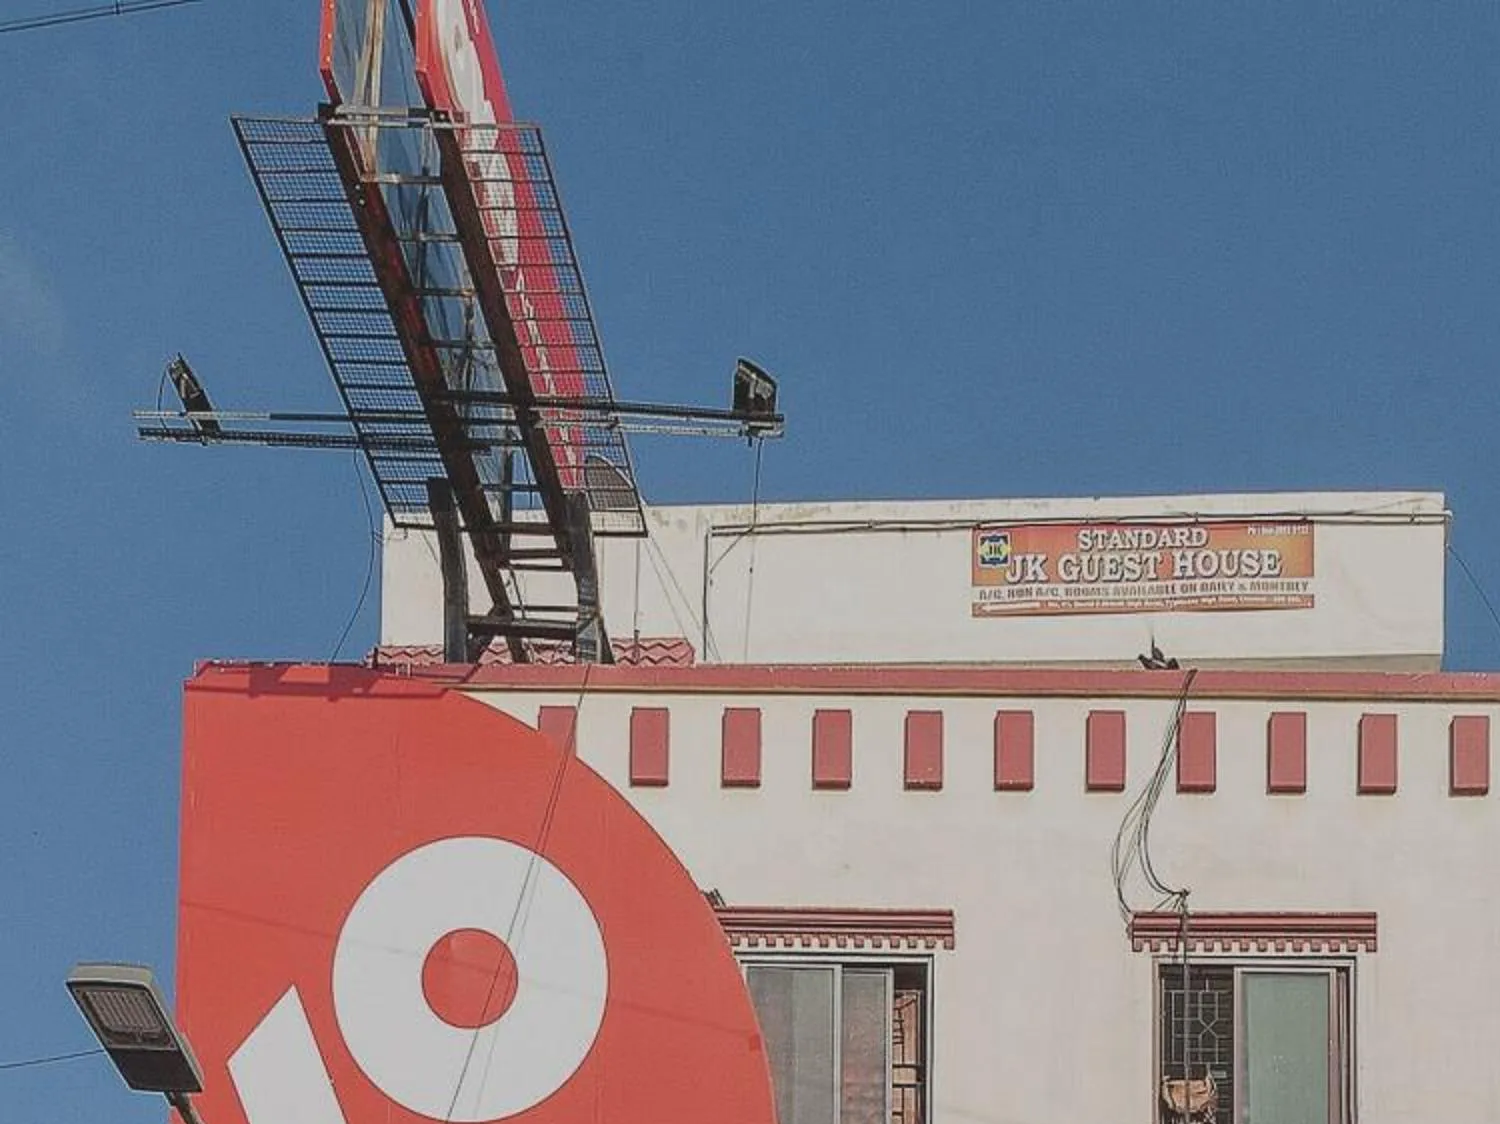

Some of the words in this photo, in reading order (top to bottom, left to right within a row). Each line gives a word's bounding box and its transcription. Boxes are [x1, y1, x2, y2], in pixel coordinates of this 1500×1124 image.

[1078, 526, 1209, 551] STANDARD
[1005, 554, 1049, 583] JK
[1058, 551, 1163, 583] GUEST
[1173, 549, 1282, 579] HOUSE
[1180, 582, 1196, 593] ON
